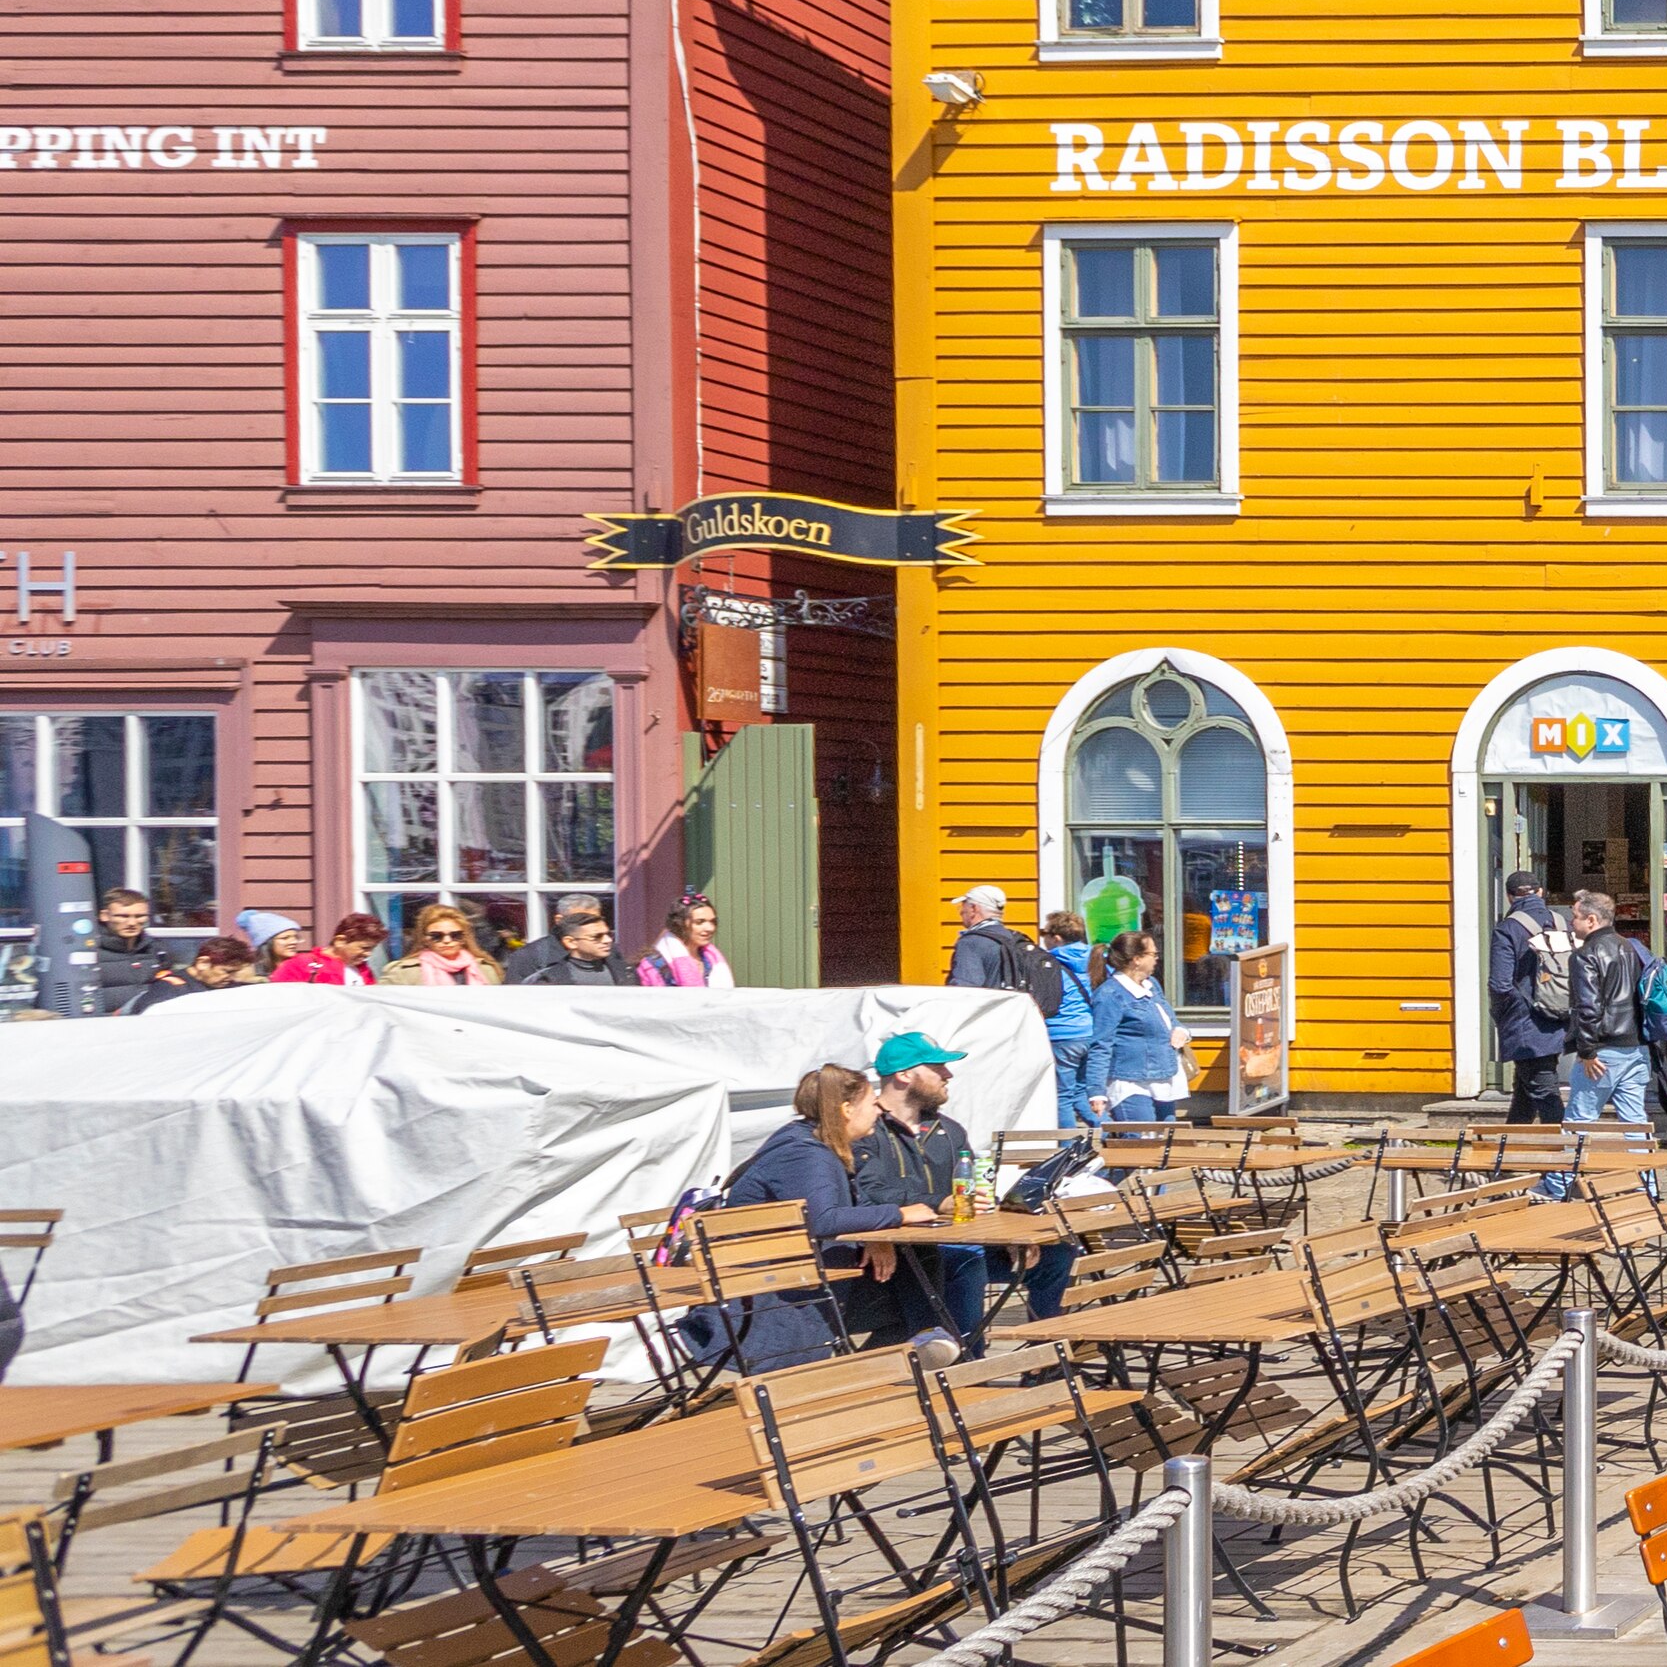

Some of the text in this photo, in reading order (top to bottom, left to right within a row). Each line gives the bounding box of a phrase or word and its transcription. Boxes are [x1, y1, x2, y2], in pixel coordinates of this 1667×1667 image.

[211, 127, 328, 169] INT
[1049, 120, 1530, 192] RADISSON
[687, 502, 832, 546] Guldskoen
[8, 640, 72, 656] CLUB
[1538, 723, 1625, 746] MIX
